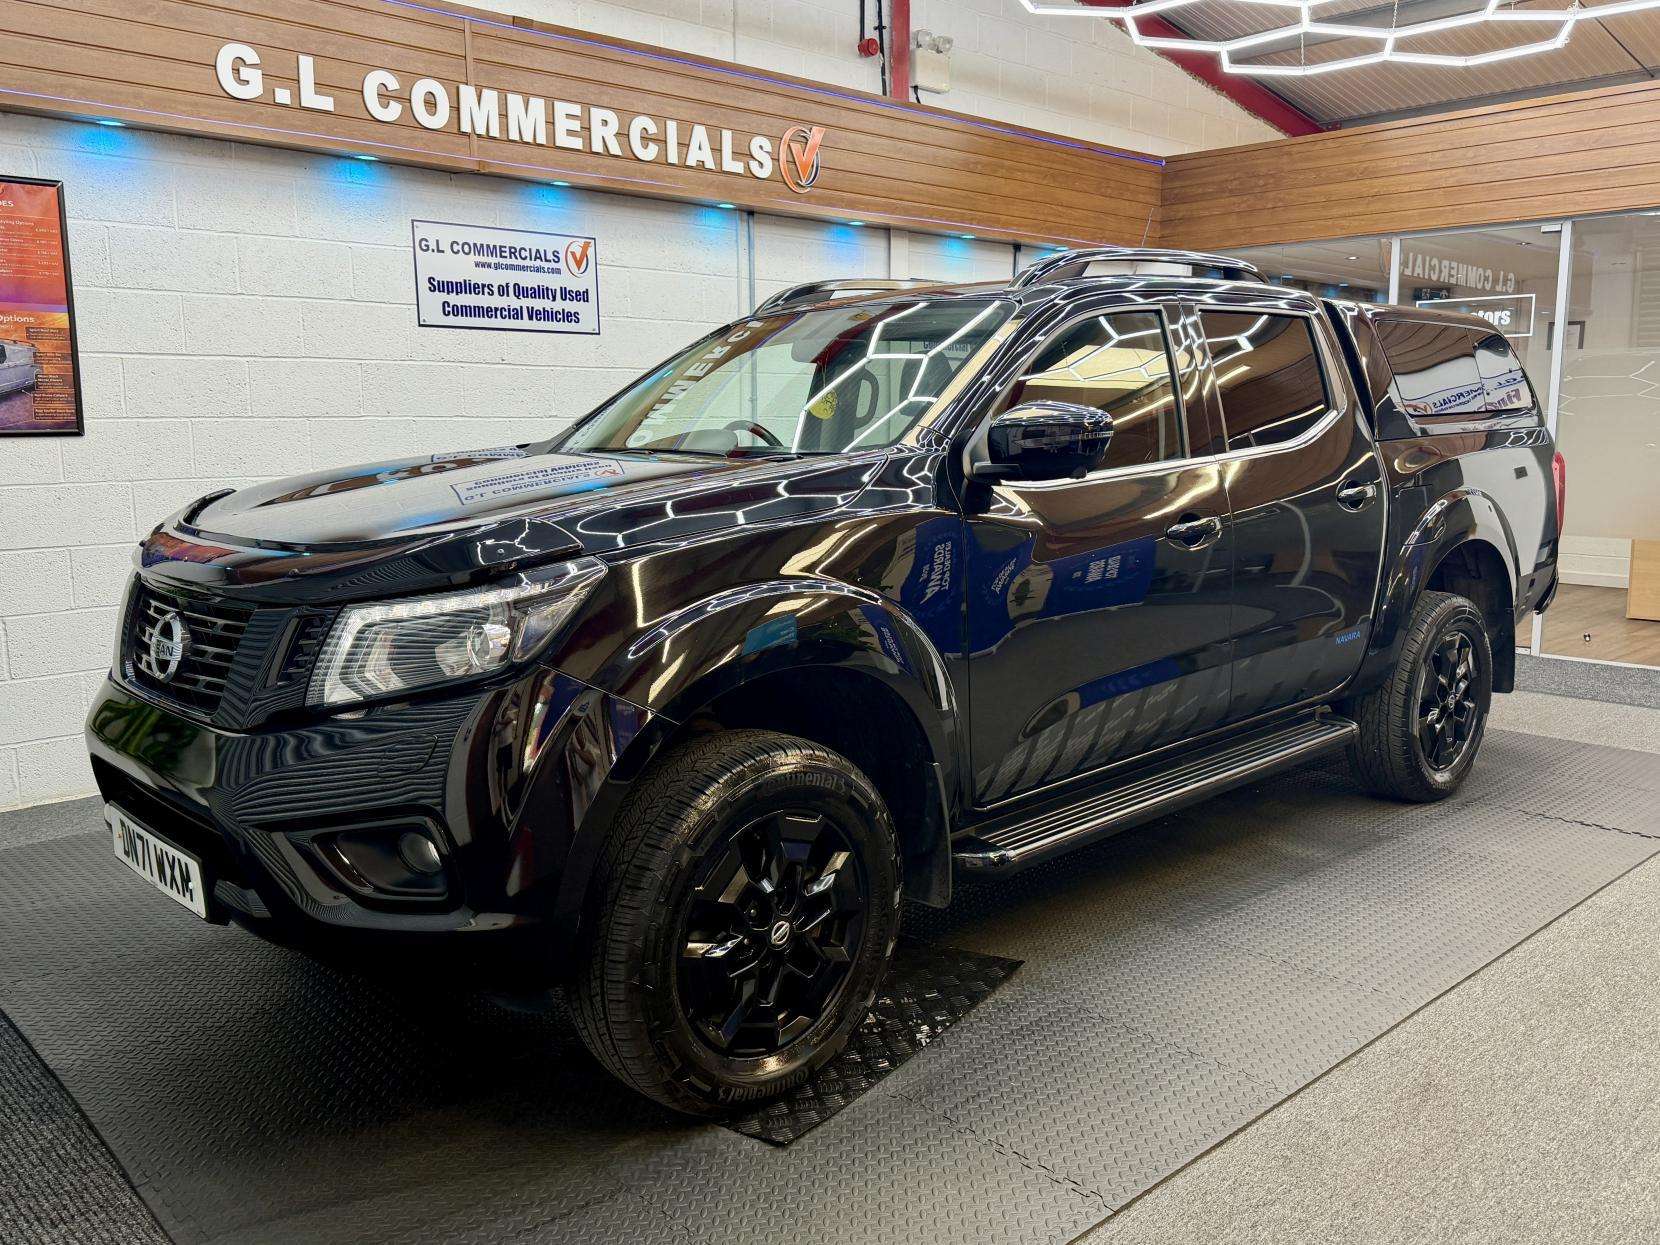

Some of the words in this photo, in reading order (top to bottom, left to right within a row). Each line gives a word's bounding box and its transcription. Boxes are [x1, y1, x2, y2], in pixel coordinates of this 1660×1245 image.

[215, 43, 335, 112] G.L
[362, 69, 773, 179] COMMERCIALS
[418, 238, 445, 254] G.L
[450, 240, 561, 263] COMMERCIALS
[474, 259, 562, 275] www.glcommercials.com
[428, 276, 494, 297] Suppliers
[497, 282, 510, 297] of
[513, 283, 557, 301] Quality
[560, 286, 589, 303] Used
[442, 301, 523, 321] Commercial
[526, 305, 580, 324] Vehicles
[1336, 630, 1360, 645] NAVARA
[120, 818, 154, 878] DN71
[154, 843, 194, 903] WXM
